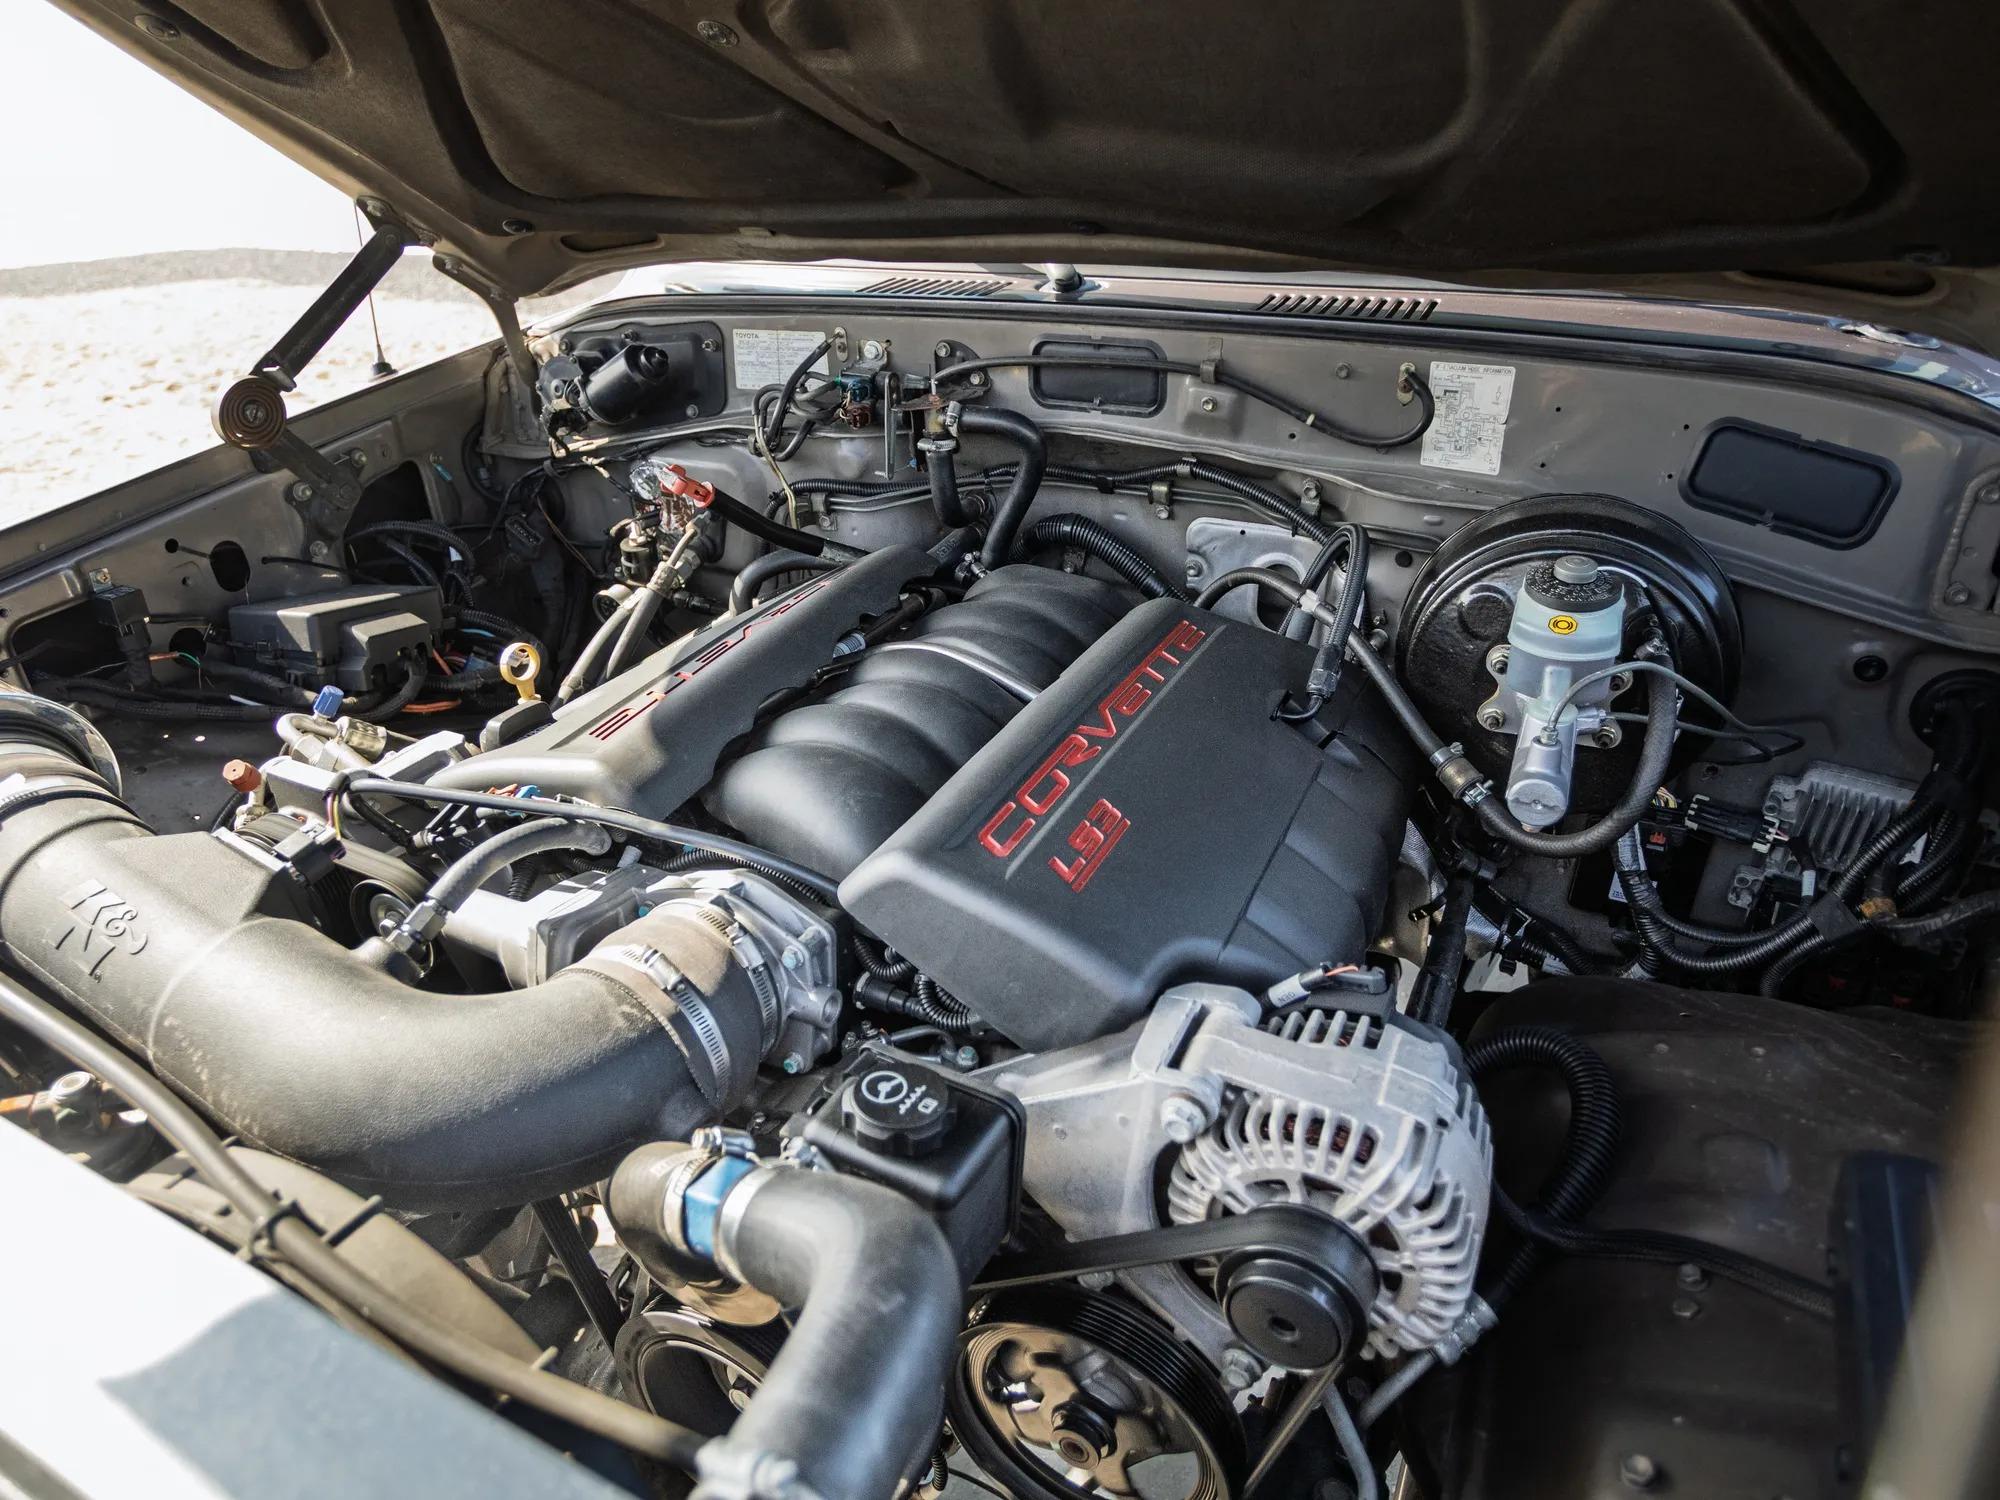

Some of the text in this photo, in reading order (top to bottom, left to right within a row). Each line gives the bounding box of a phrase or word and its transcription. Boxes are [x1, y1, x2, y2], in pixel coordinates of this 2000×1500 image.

[978, 619, 1206, 857] CORVETTE
[1048, 798, 1123, 884] LS3
[44, 878, 149, 977] K&N
